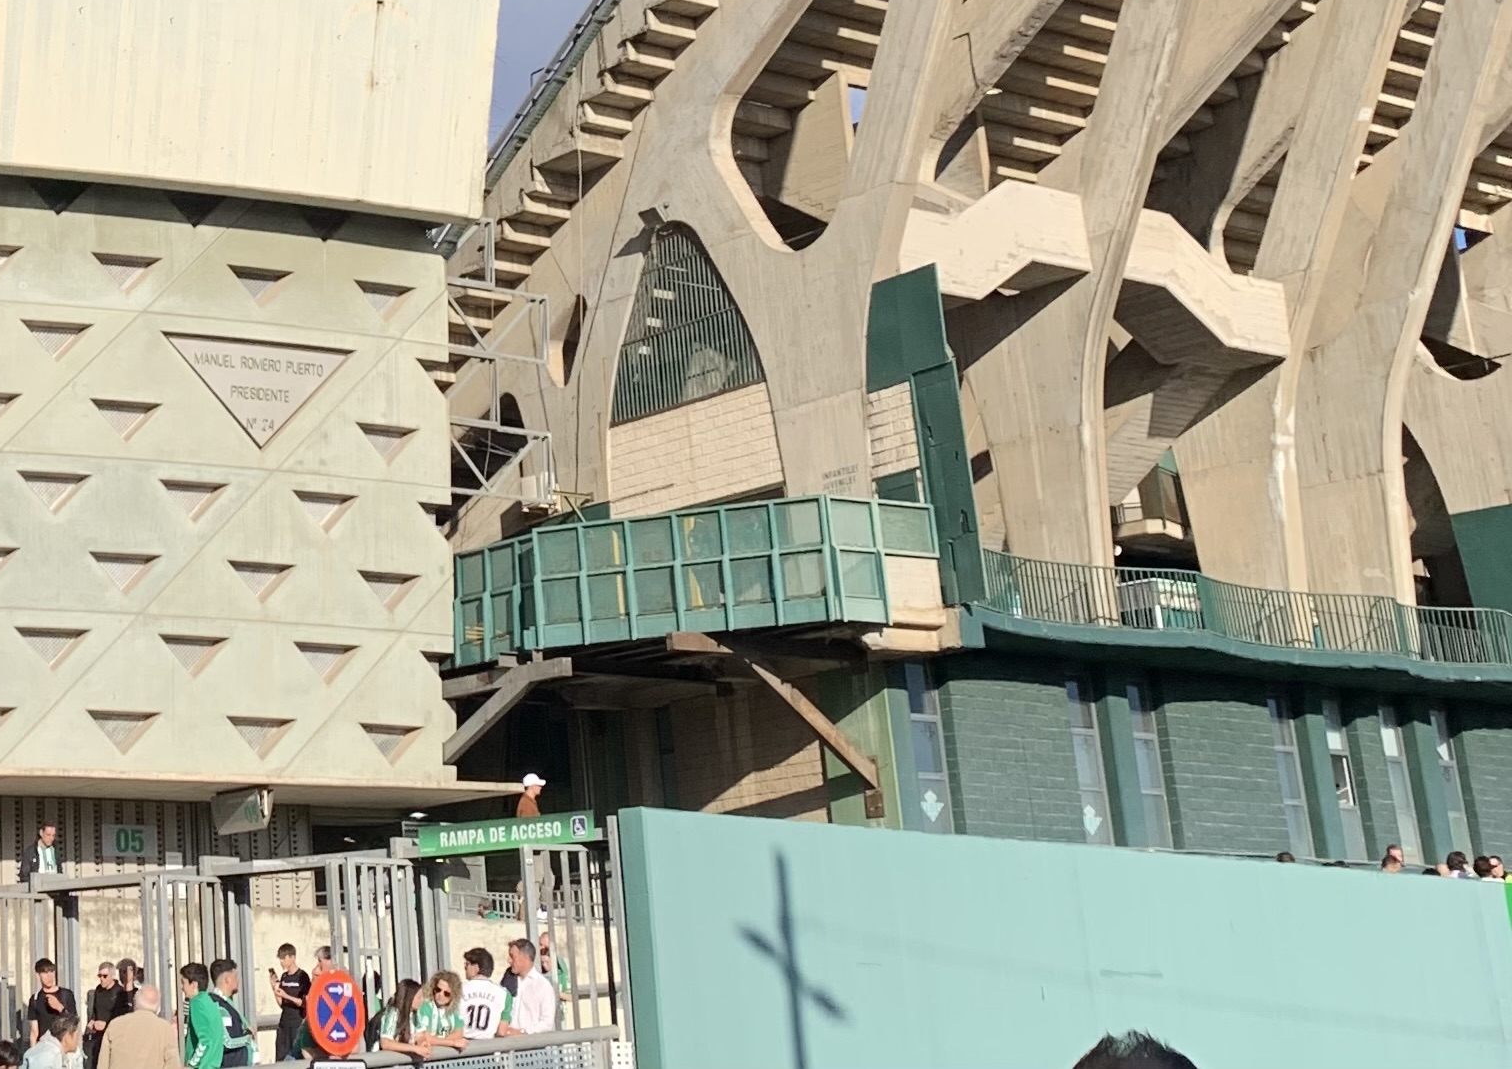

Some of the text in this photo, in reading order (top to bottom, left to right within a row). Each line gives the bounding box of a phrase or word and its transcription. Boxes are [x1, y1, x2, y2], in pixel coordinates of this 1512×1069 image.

[194, 352, 324, 378] MANUEL ROMERO PUERTO
[230, 385, 289, 404] PRESIDENTE
[261, 418, 275, 432] 24
[115, 827, 144, 853] 05
[440, 821, 562, 847] RAMPA DE ACCESO
[467, 1004, 491, 1031] 10
